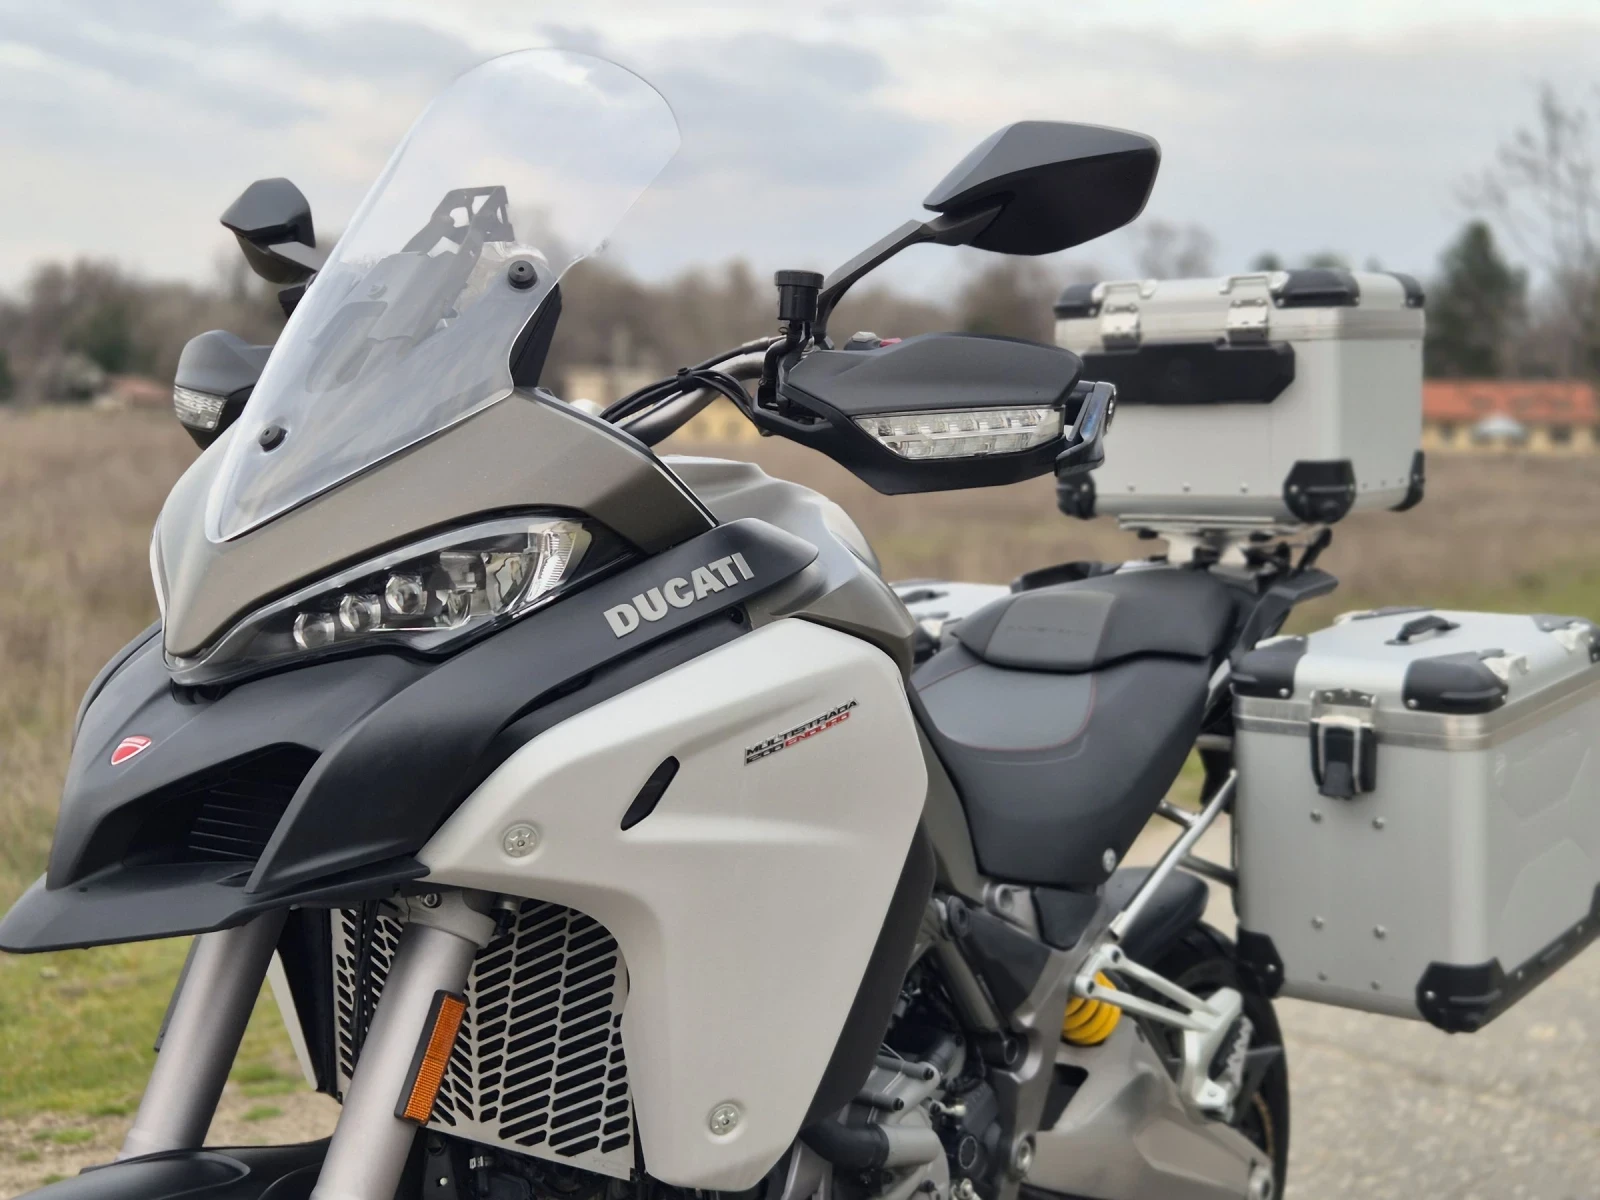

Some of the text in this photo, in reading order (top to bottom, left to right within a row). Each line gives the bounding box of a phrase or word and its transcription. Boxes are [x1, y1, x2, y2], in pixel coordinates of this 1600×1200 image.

[603, 552, 755, 638] DUCATI
[746, 700, 857, 756] MULTISTRADA
[746, 712, 850, 764] 1200 ENDURO
